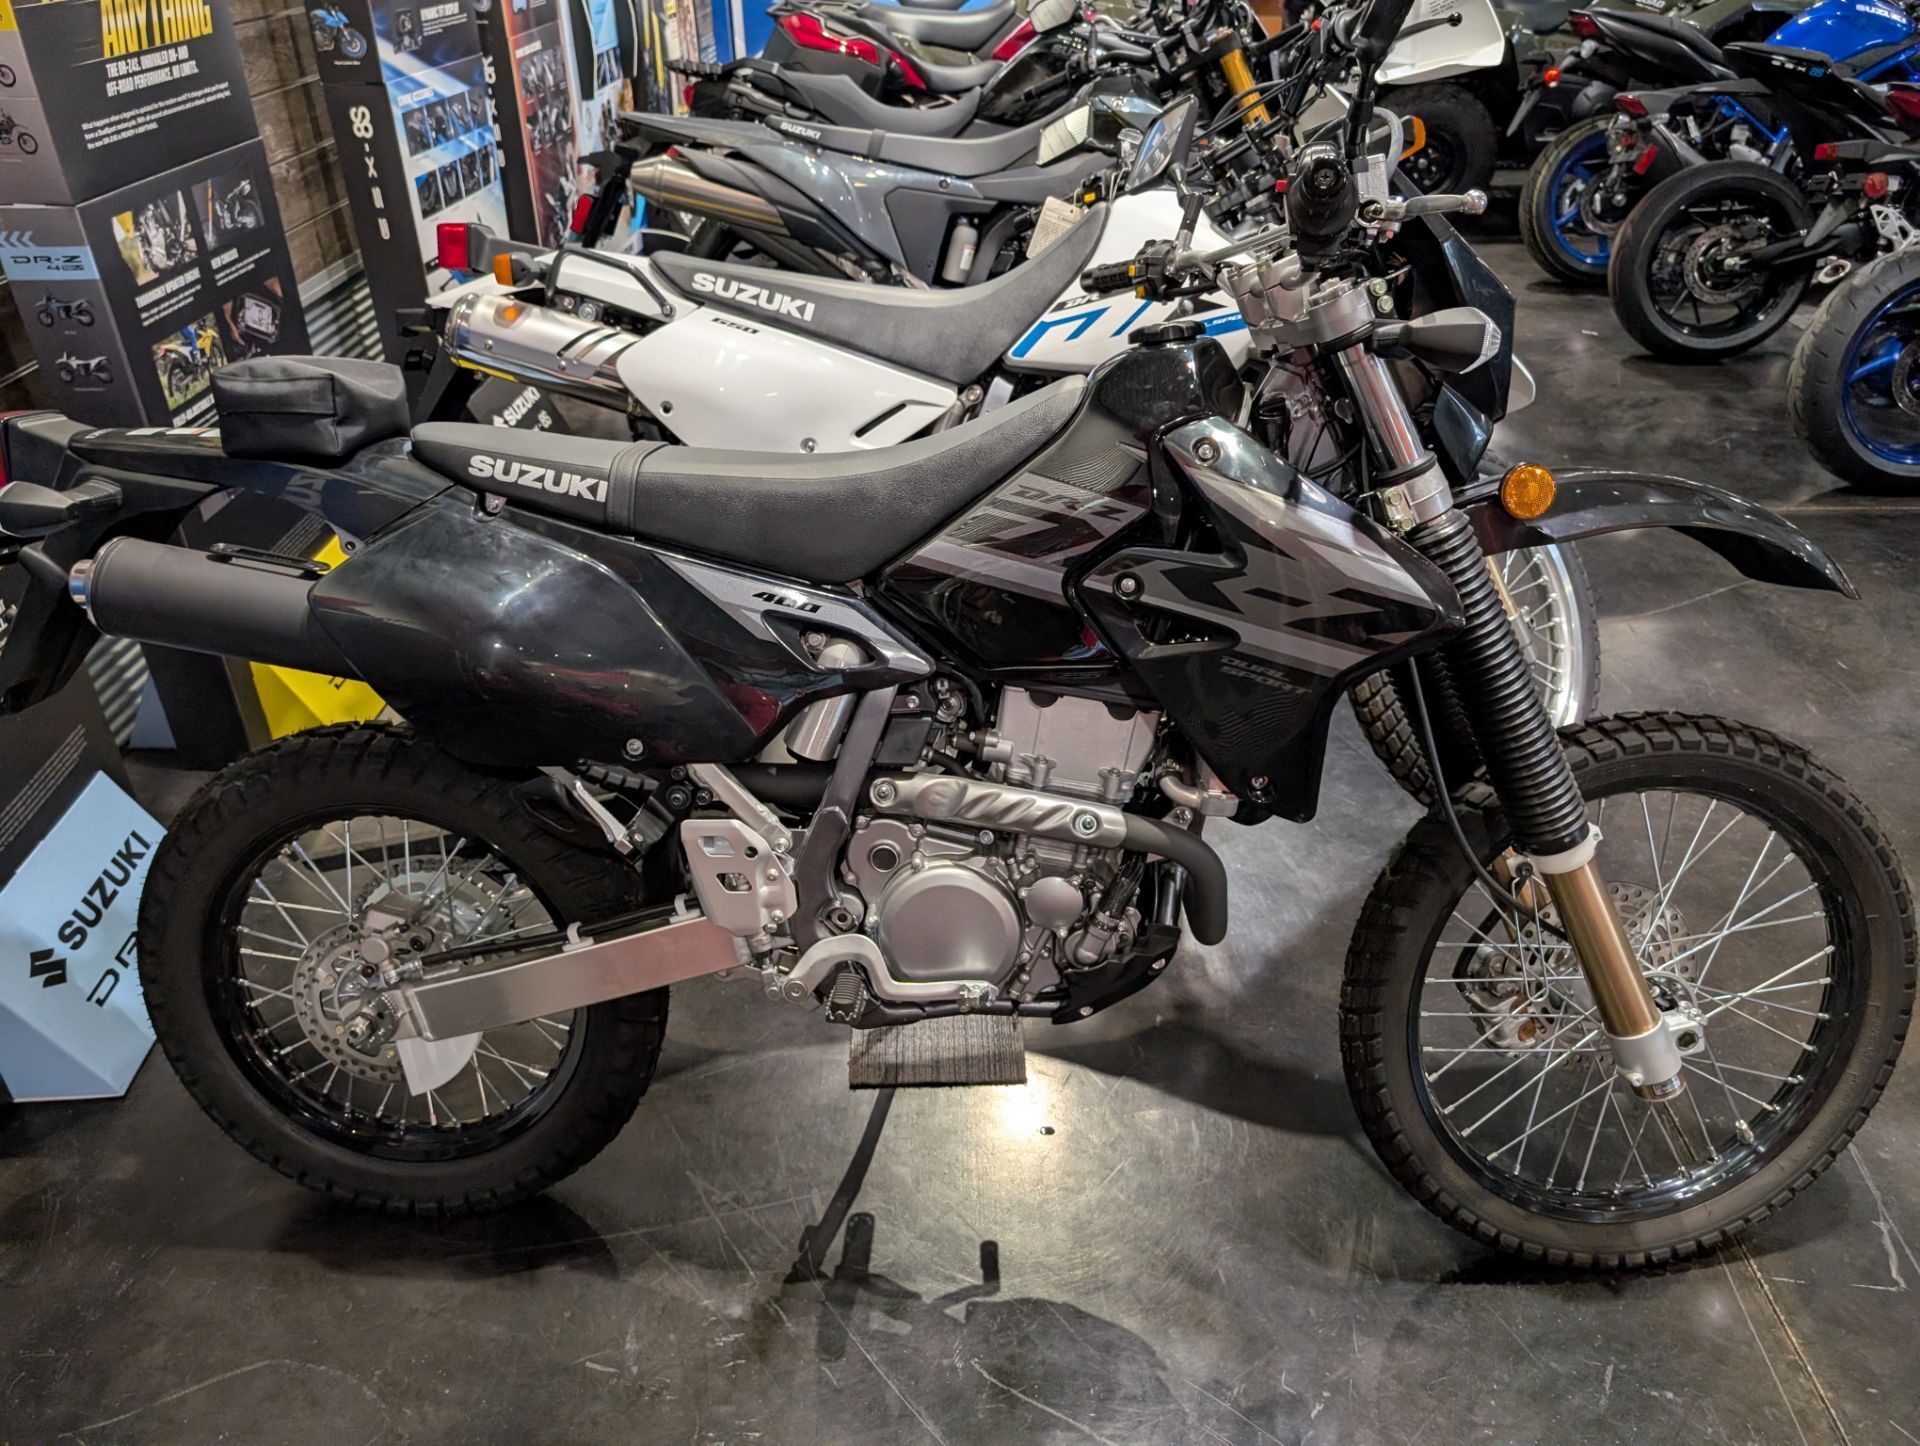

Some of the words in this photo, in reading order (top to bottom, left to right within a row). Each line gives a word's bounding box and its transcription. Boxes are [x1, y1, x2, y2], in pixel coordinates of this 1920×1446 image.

[1856, 3, 1908, 24] SUZUKI
[780, 121, 821, 140] SUZUKI
[11, 255, 82, 264] DR-Z
[691, 272, 816, 322] SUZUKI
[710, 317, 761, 335] 650
[503, 385, 541, 426] SUZUKI
[468, 454, 609, 503] SUZUKI
[752, 591, 823, 614] 400
[1219, 665, 1313, 694] SPORT
[1220, 655, 1291, 682] DUAL
[57, 829, 152, 952] SUZUKI
